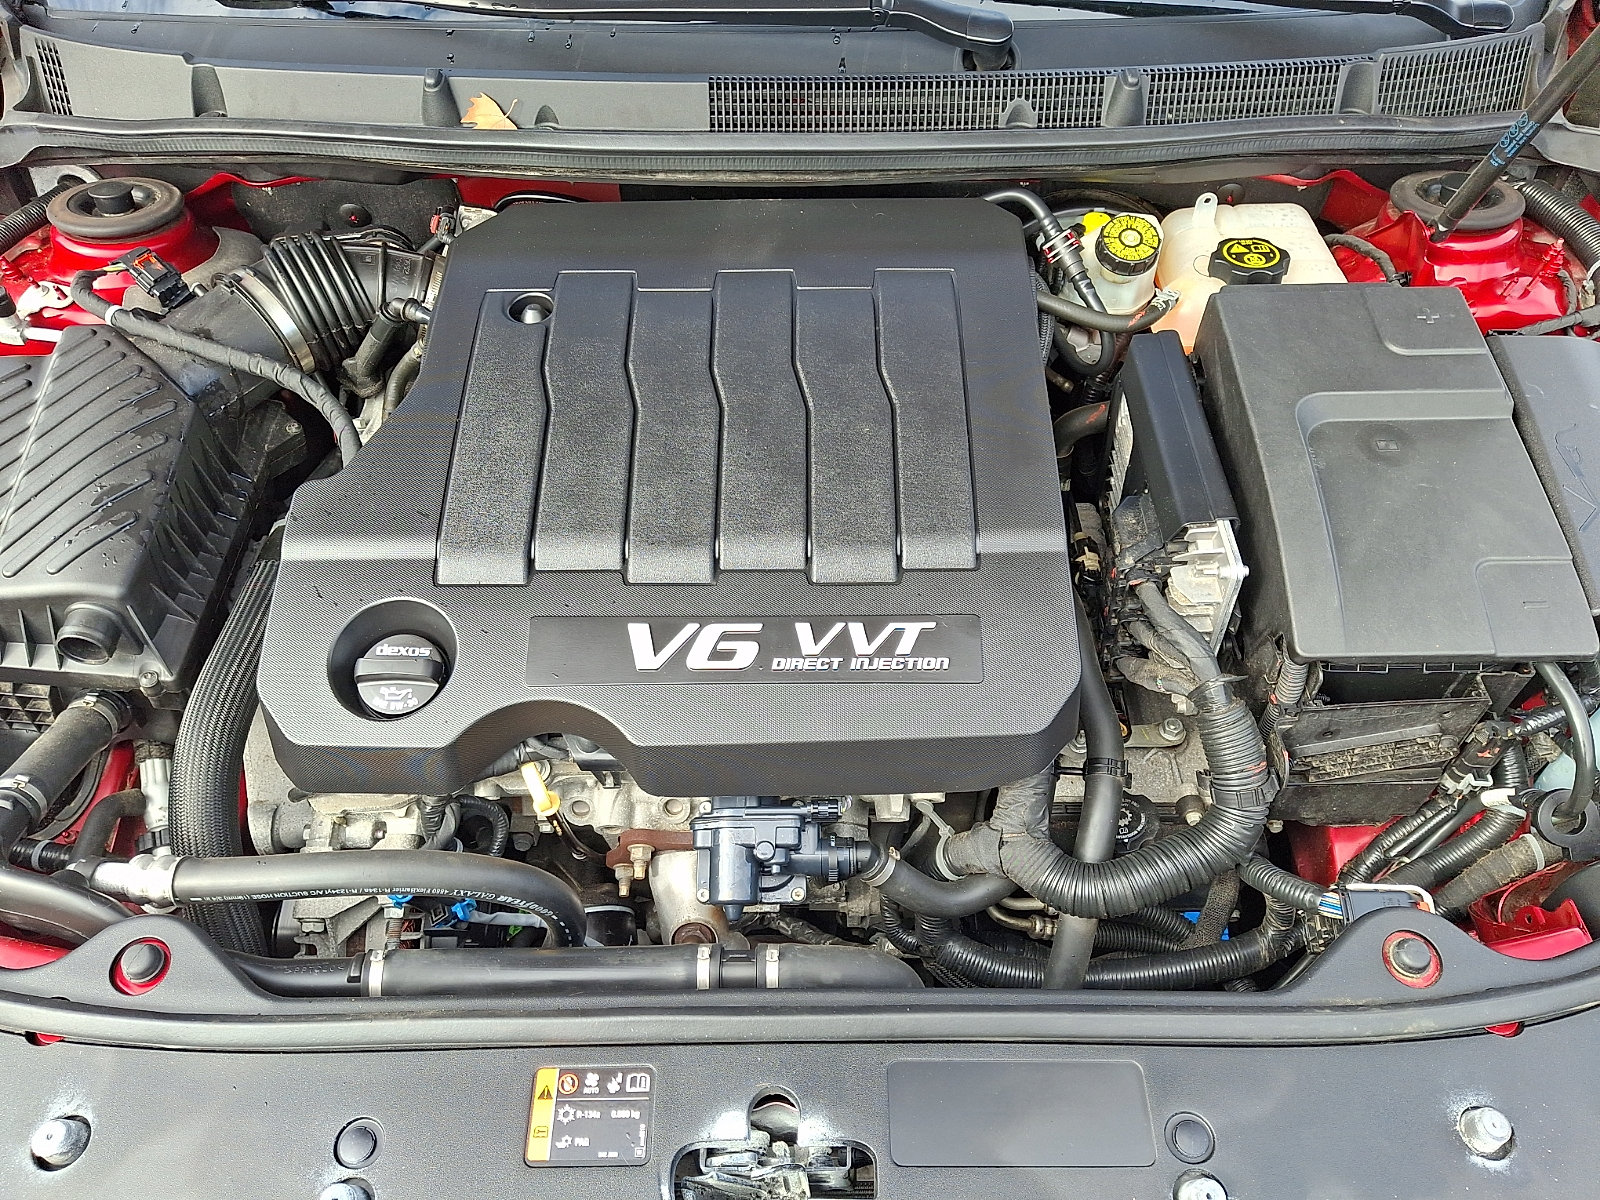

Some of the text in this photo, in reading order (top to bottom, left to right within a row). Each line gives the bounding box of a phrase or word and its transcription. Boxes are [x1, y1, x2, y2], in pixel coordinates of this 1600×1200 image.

[376, 644, 432, 656] dexos
[627, 621, 938, 672] V6 VVT
[771, 656, 950, 672] DIRECT INJECTION
[274, 890, 309, 899] SUCTION
[449, 888, 496, 900] GALAXY
[496, 894, 554, 918] GOODYEAR
